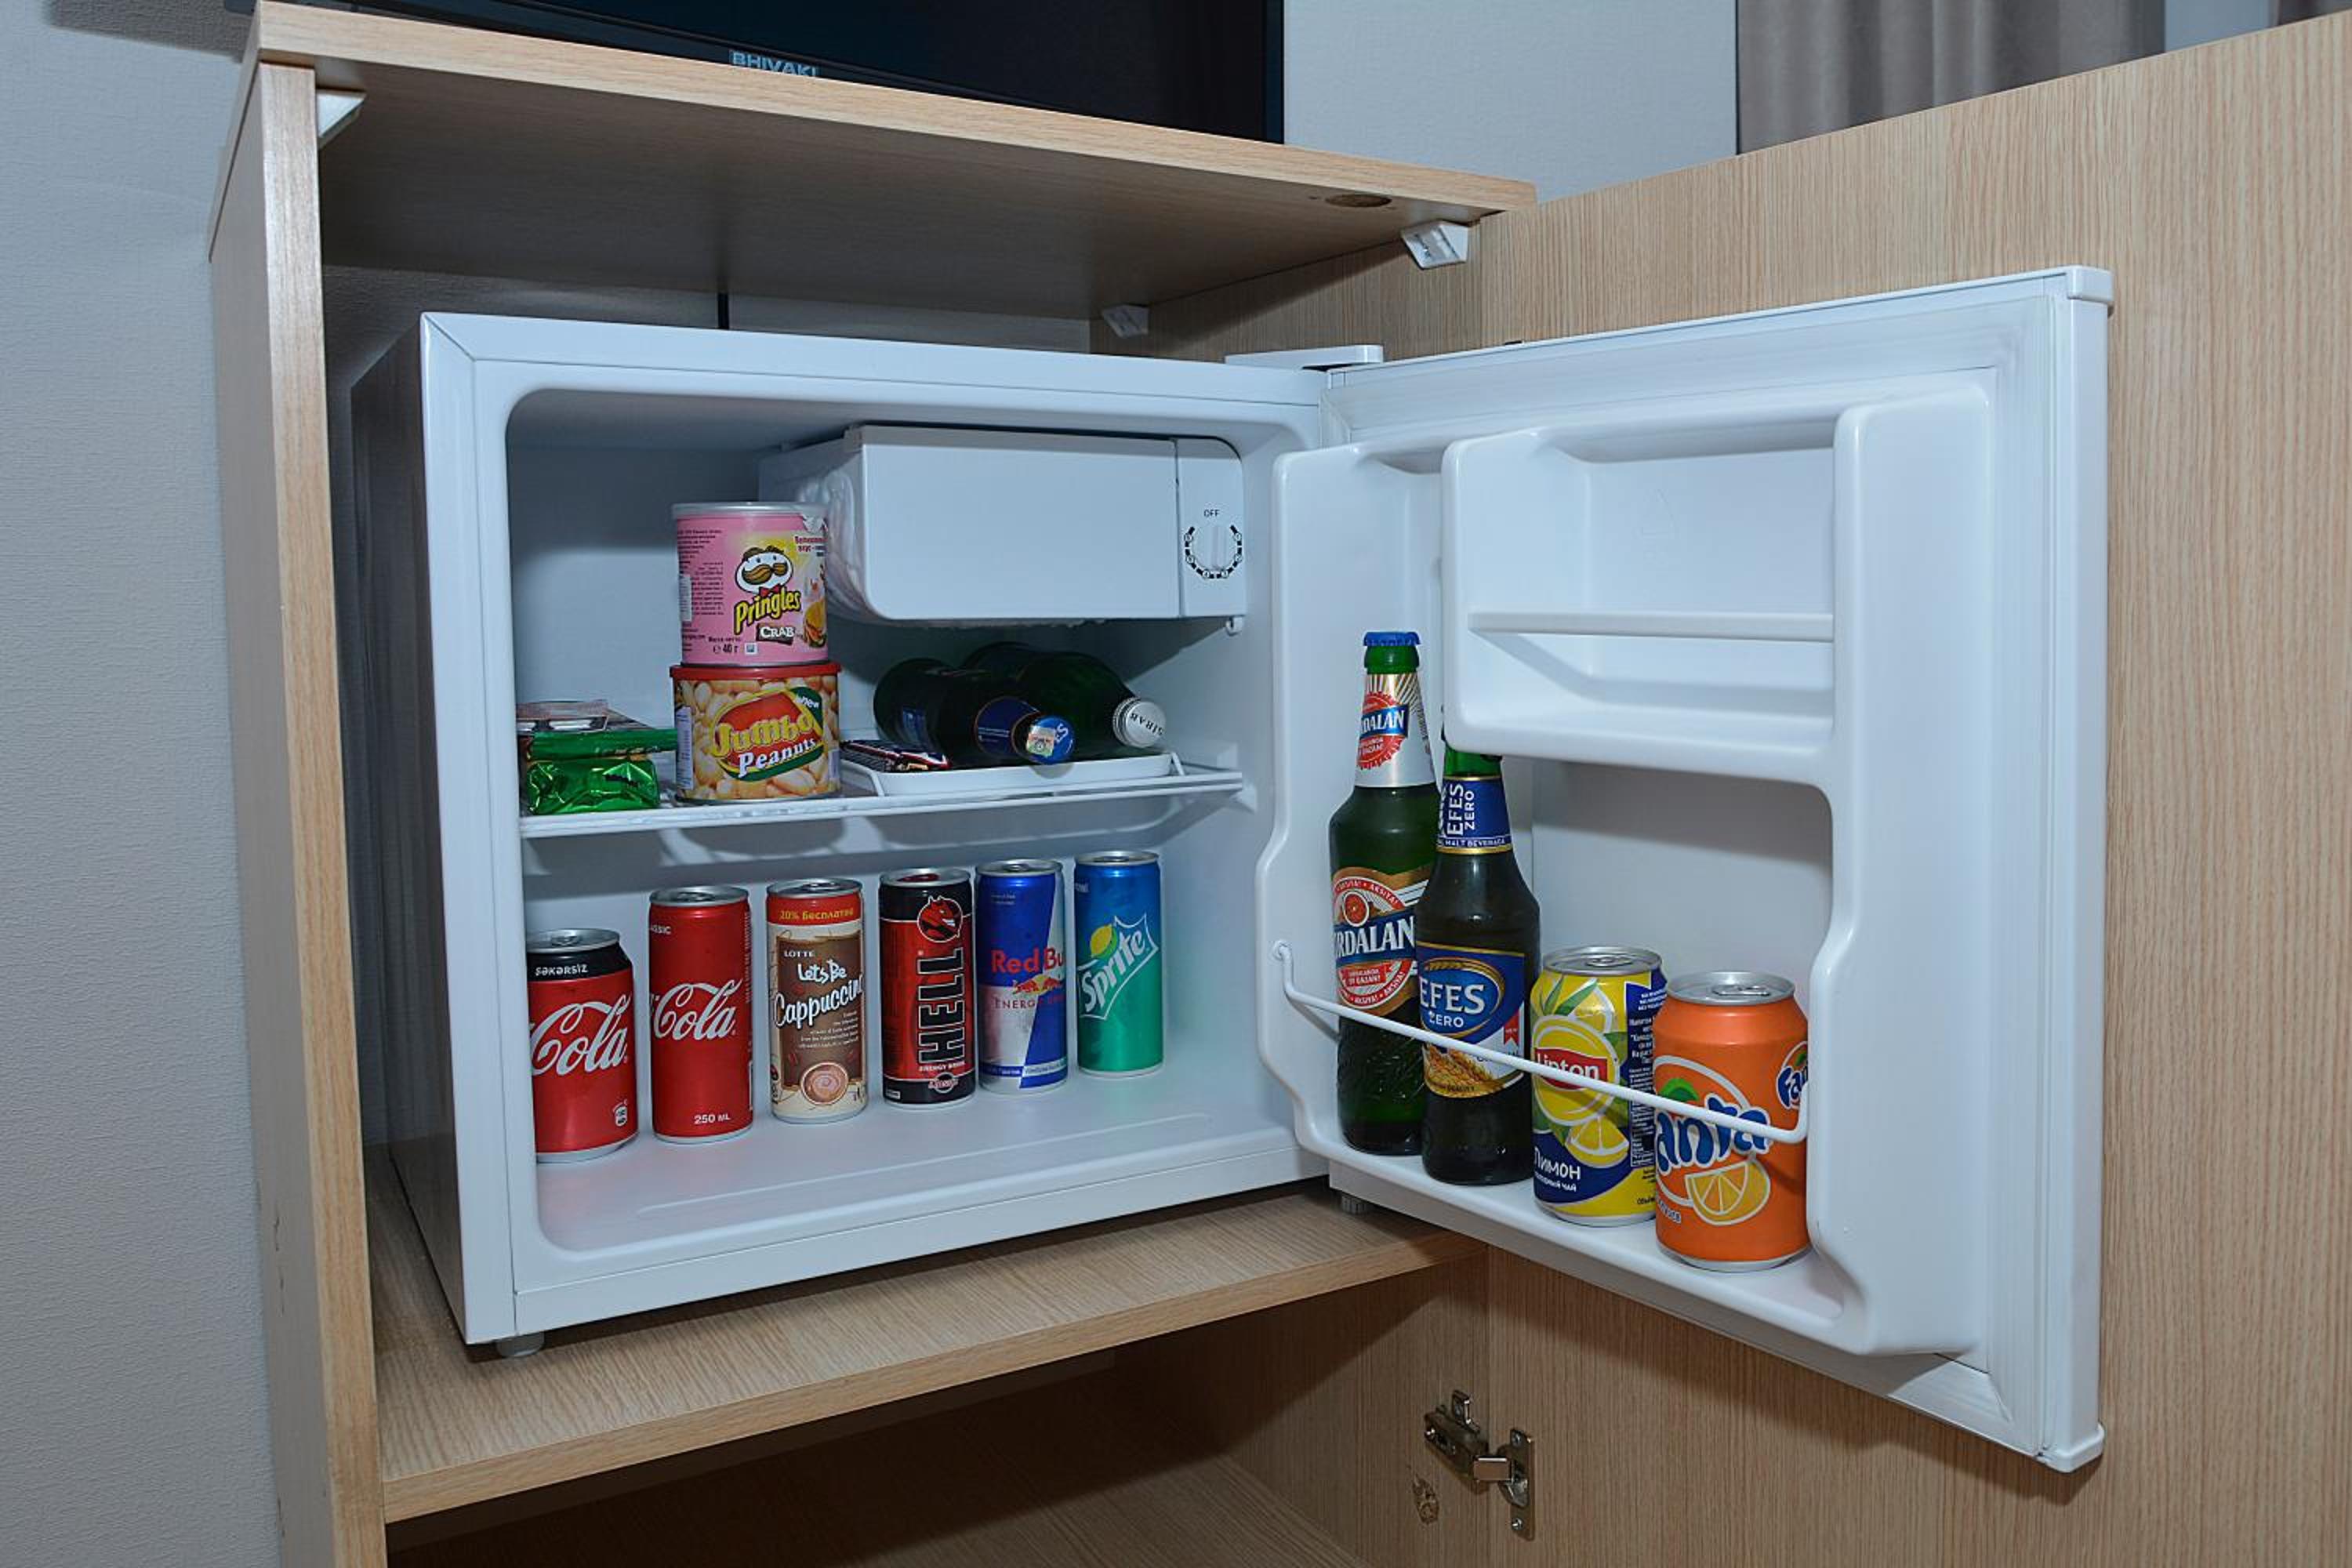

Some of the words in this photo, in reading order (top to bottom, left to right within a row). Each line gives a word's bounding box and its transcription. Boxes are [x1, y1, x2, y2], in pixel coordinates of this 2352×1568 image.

[1203, 509, 1221, 517] OFF
[734, 585, 802, 635] Pringles
[760, 626, 795, 638] CRAB
[711, 713, 815, 757] Jumbo
[1362, 710, 1405, 734] DALAN
[738, 738, 816, 778] Peanuts
[1446, 783, 1464, 836] EFES
[1464, 790, 1475, 830] ZERO
[1334, 915, 1415, 958] RDALAN
[990, 946, 1040, 974] Red
[1043, 947, 1065, 971] Bu
[1082, 930, 1145, 1012] Sprite
[654, 978, 743, 1040] Cola
[916, 947, 965, 1064] HELL
[1419, 976, 1486, 1014] EFES
[530, 993, 630, 1076] Cola
[1428, 1011, 1464, 1028] ZERO
[694, 1114, 716, 1125] 250
[1656, 1093, 1773, 1174] anta
